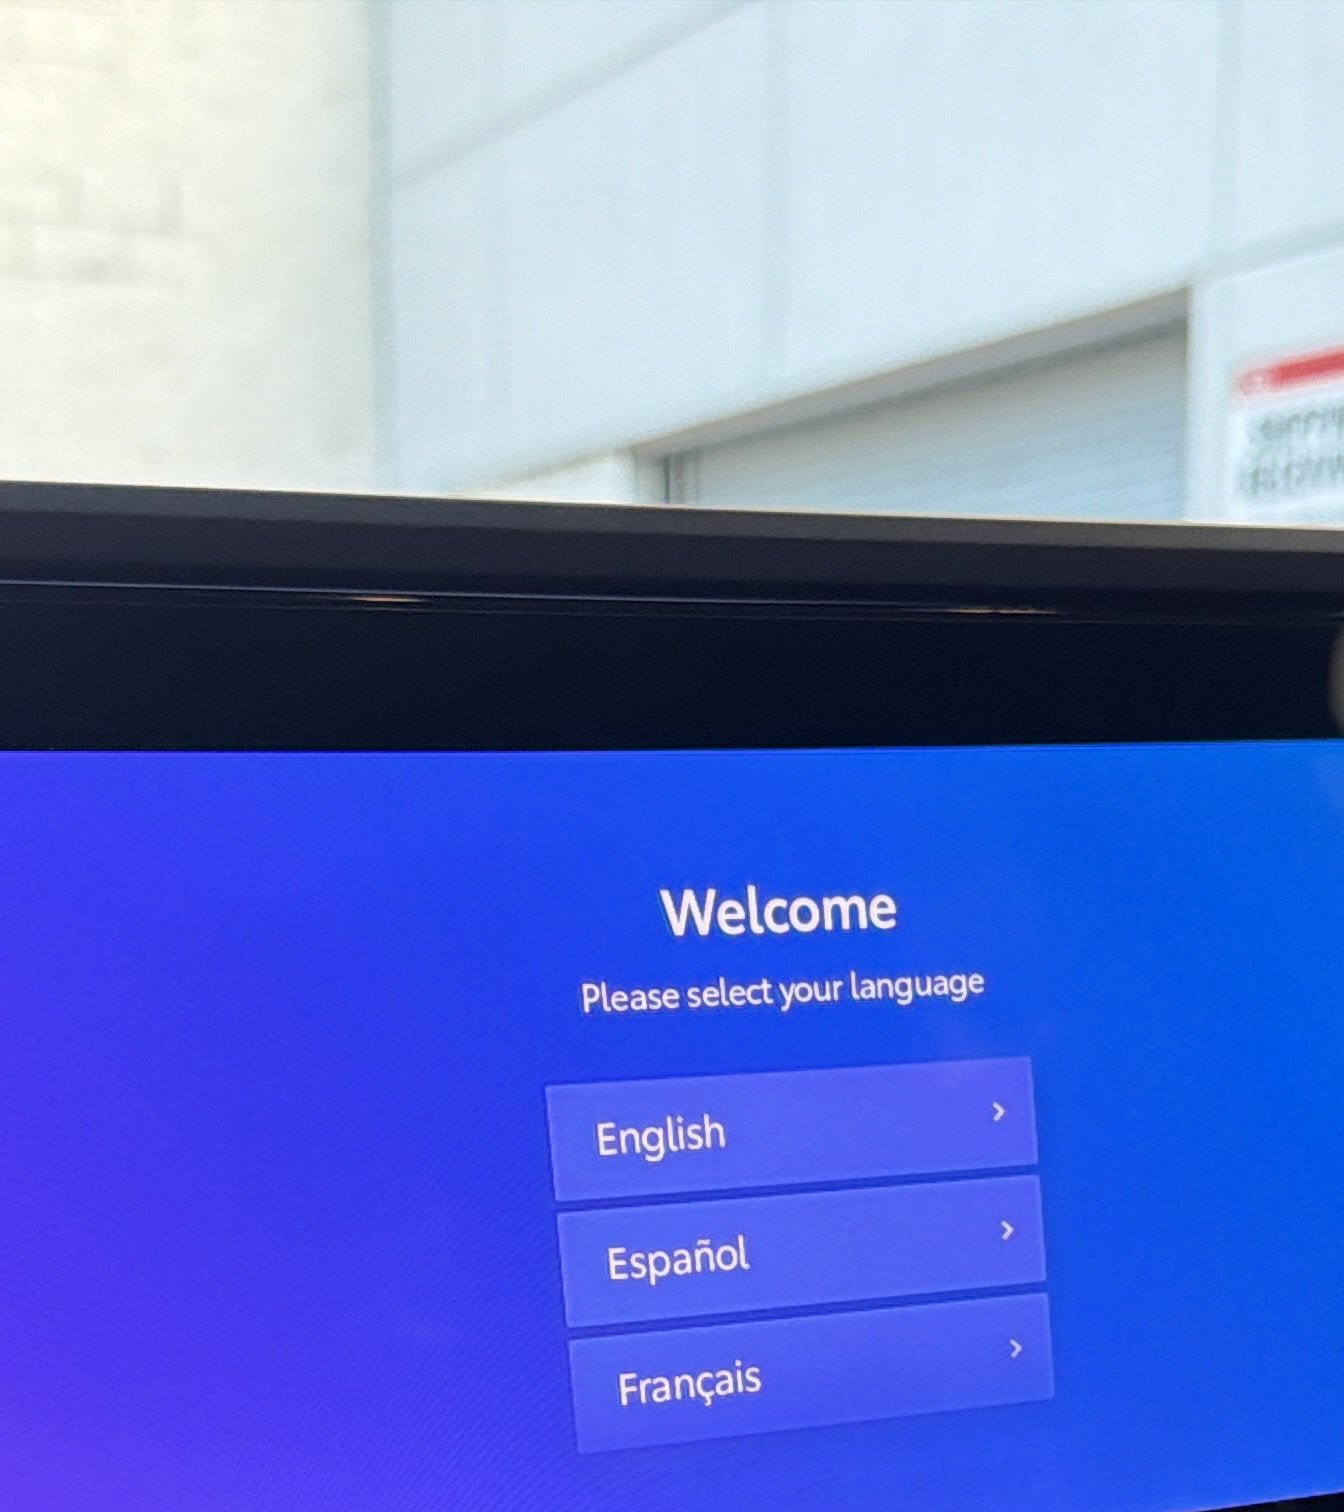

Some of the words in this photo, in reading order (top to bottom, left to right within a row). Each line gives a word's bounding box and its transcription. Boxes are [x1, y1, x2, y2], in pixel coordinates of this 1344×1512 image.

[659, 884, 897, 937] Welcome
[581, 981, 680, 1014] Please
[687, 976, 774, 1008] select
[779, 978, 844, 1012] your
[850, 970, 985, 1005] language
[596, 1113, 726, 1162] English
[607, 1235, 750, 1286] Español
[618, 1360, 762, 1407] Français
